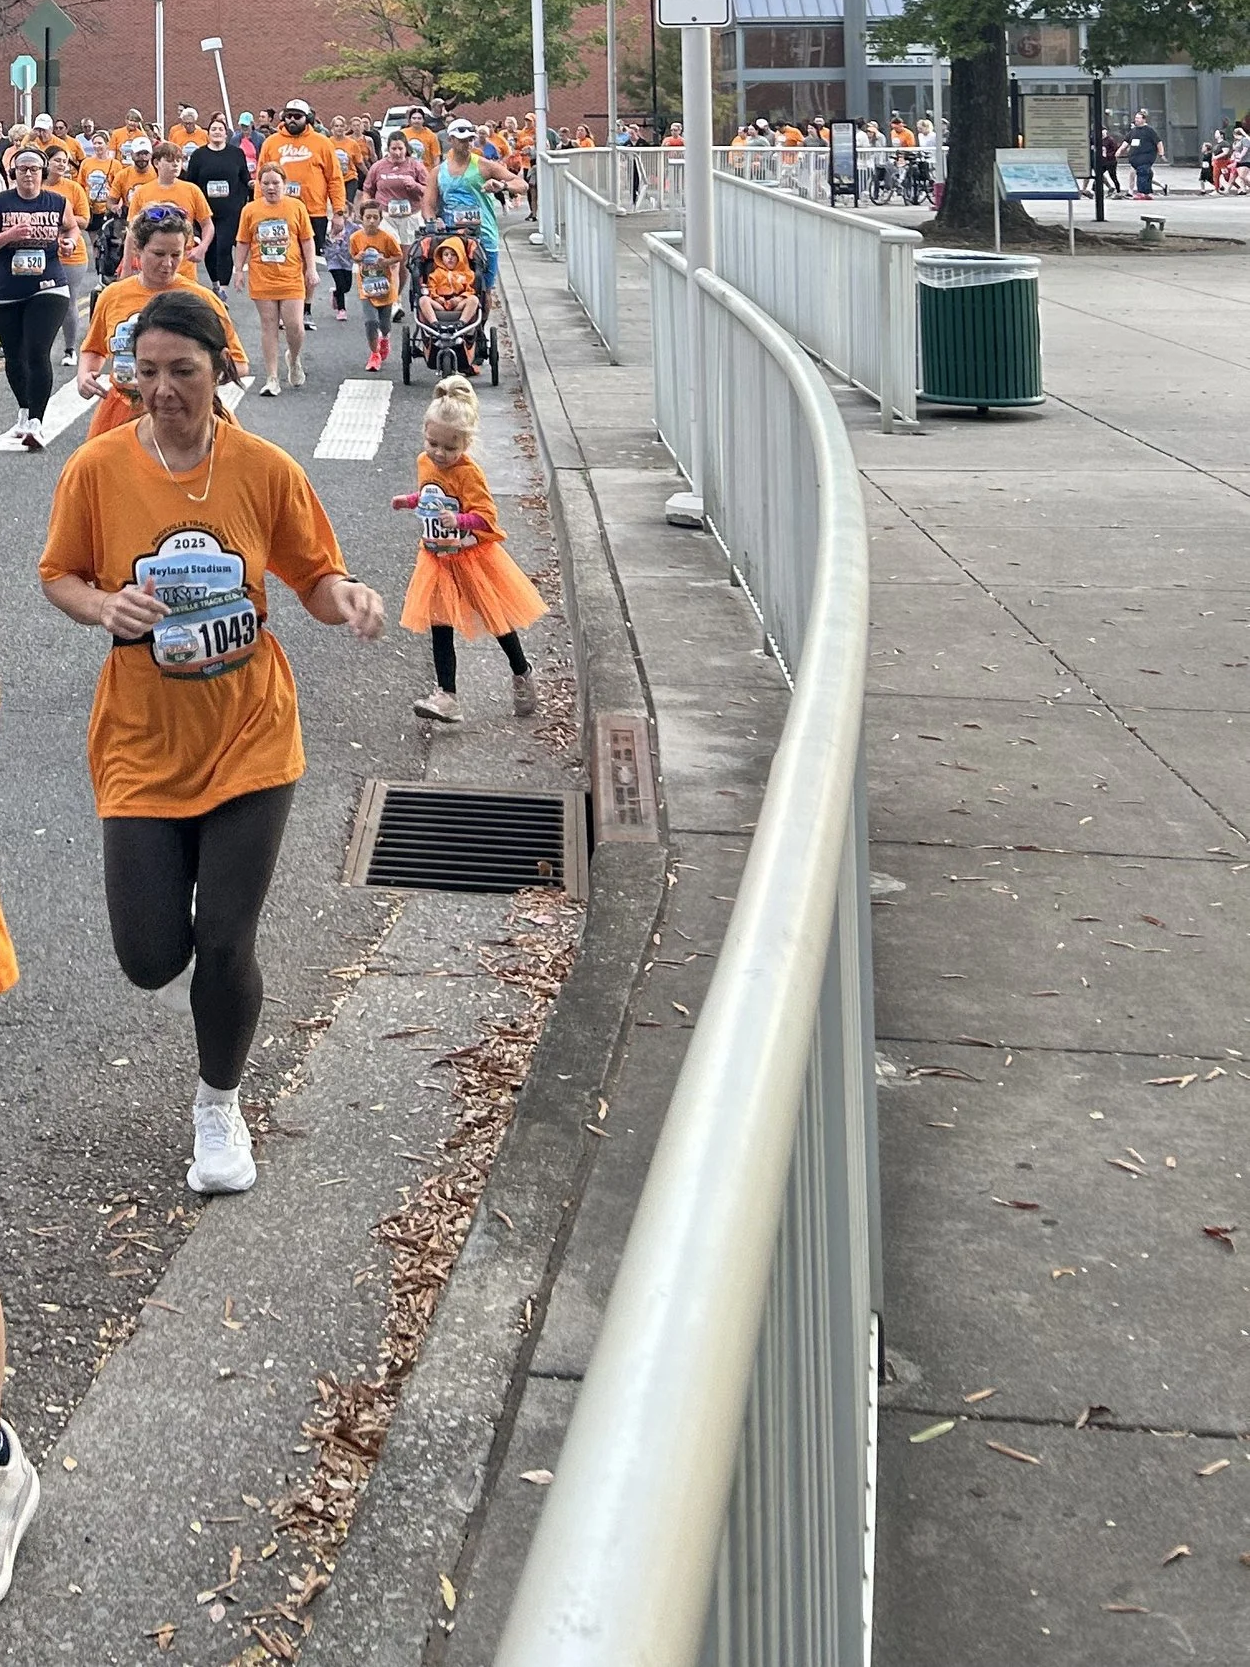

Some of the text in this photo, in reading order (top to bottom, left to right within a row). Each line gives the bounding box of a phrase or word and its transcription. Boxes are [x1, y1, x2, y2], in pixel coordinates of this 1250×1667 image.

[278, 144, 312, 162] Vols
[272, 225, 286, 236] 525
[27, 257, 42, 268] 520
[174, 537, 206, 549] 2025
[149, 564, 232, 577] Neyland Stadium
[199, 613, 255, 657] 1043
